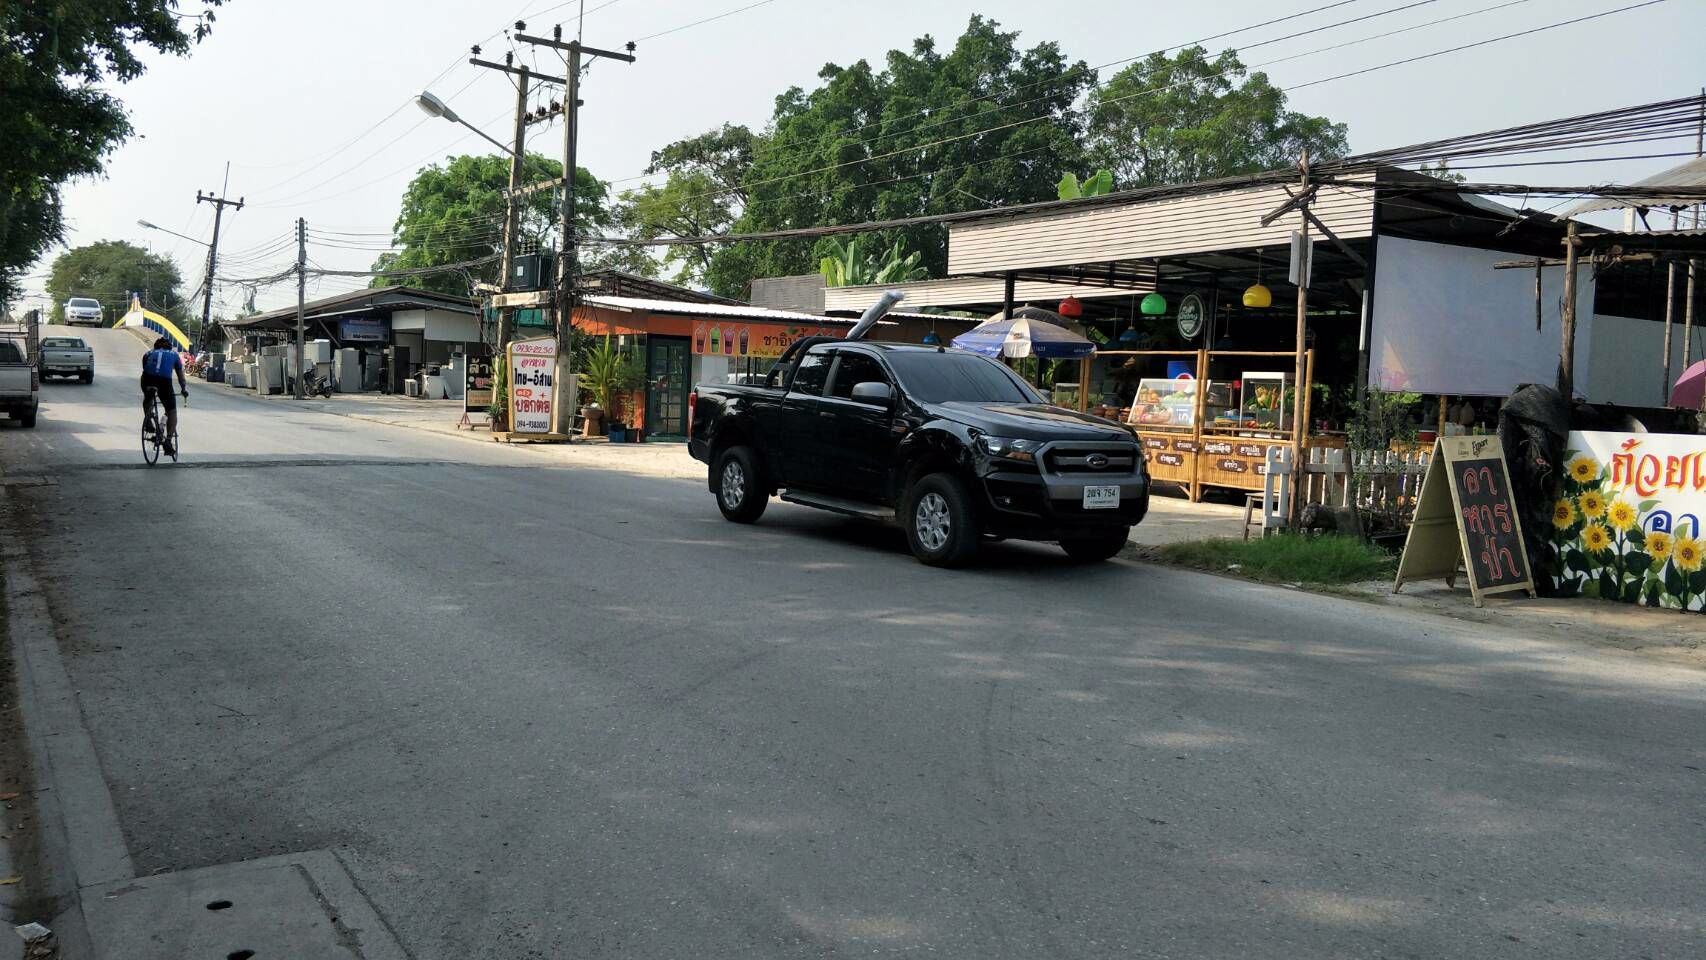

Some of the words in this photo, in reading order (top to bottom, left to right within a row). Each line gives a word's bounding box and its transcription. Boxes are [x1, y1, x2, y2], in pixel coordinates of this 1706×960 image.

[514, 368, 552, 387] ไทย-อีสาน
[1104, 488, 1116, 498] 754
